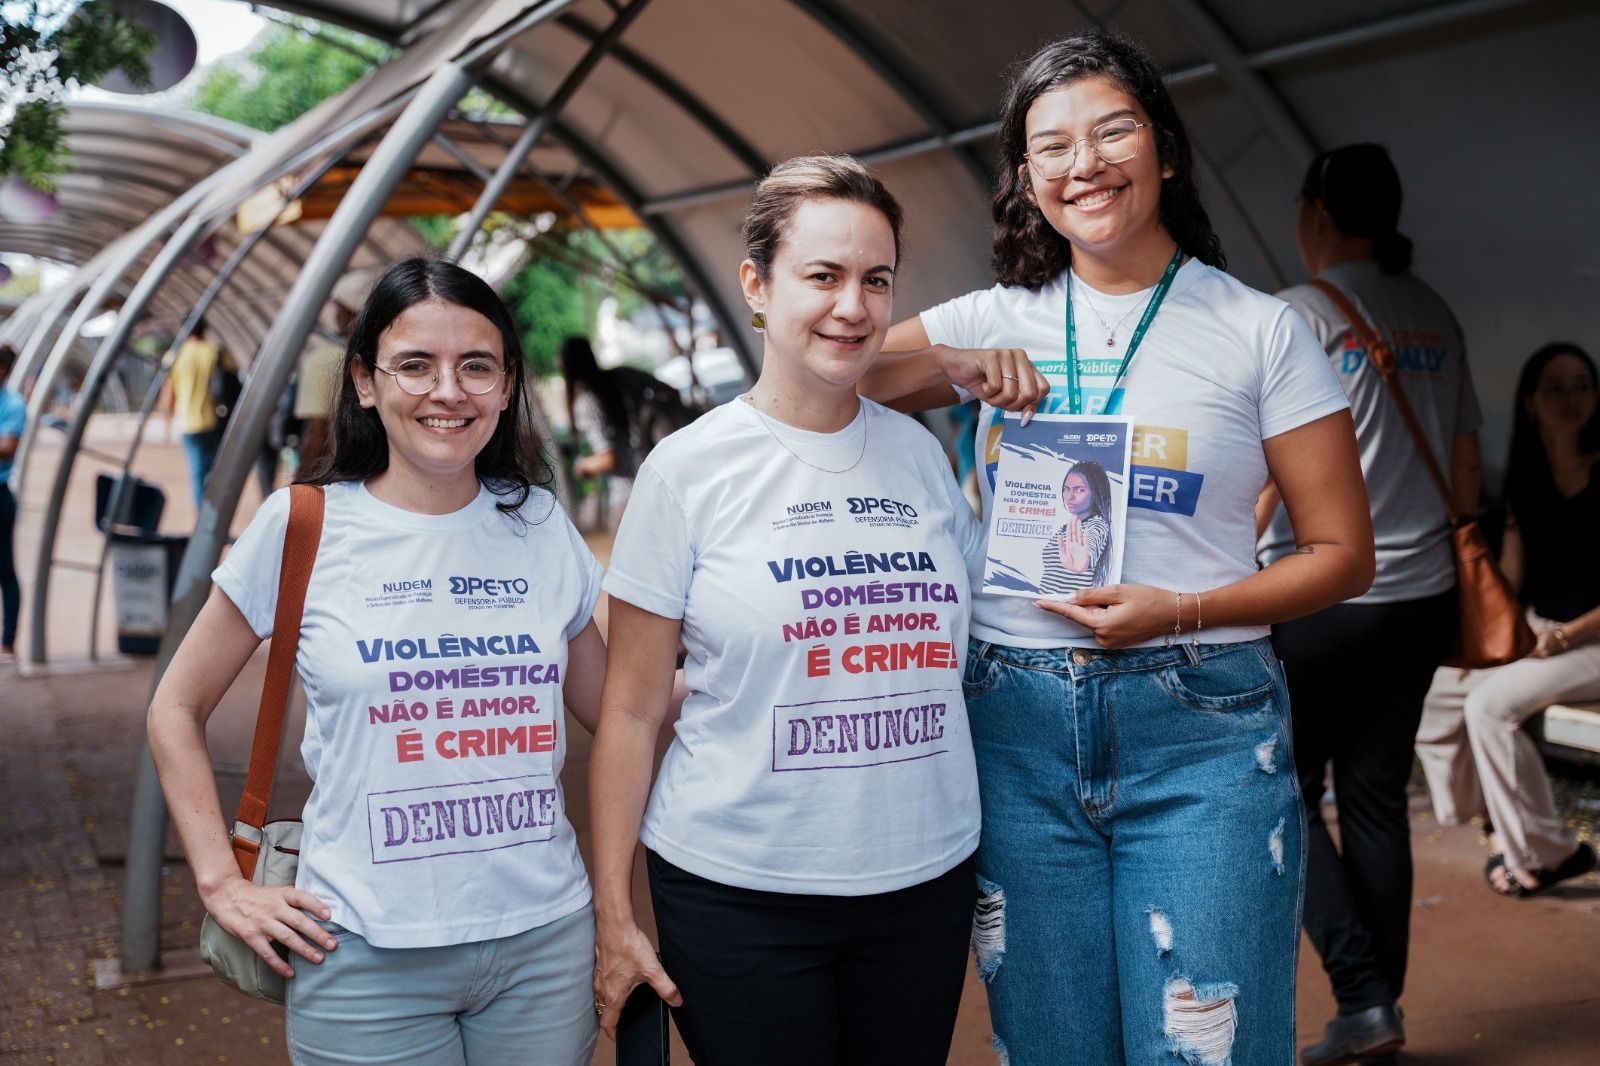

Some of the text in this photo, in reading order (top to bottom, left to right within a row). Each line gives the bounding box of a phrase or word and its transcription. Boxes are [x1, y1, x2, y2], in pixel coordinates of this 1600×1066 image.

[787, 500, 832, 514] NUDEM
[1019, 506, 1056, 517] CRIME!
[1001, 521, 1053, 536] DENUNCIE
[767, 551, 937, 583] VIOLÊNCIA
[383, 579, 432, 592] NUDEM
[801, 580, 959, 610] DOMÉSTICA
[782, 612, 941, 643] NÃO É AMOR,
[356, 633, 541, 663] VIOLÊNCIA
[807, 640, 958, 678] É CRIME!
[388, 664, 560, 692] DOMÉSTICA
[368, 695, 540, 724] NÃO É AMOR,
[396, 720, 557, 763] É CRIME!
[787, 703, 946, 756] DENUNCIE
[380, 788, 556, 847] DENUNCIE
